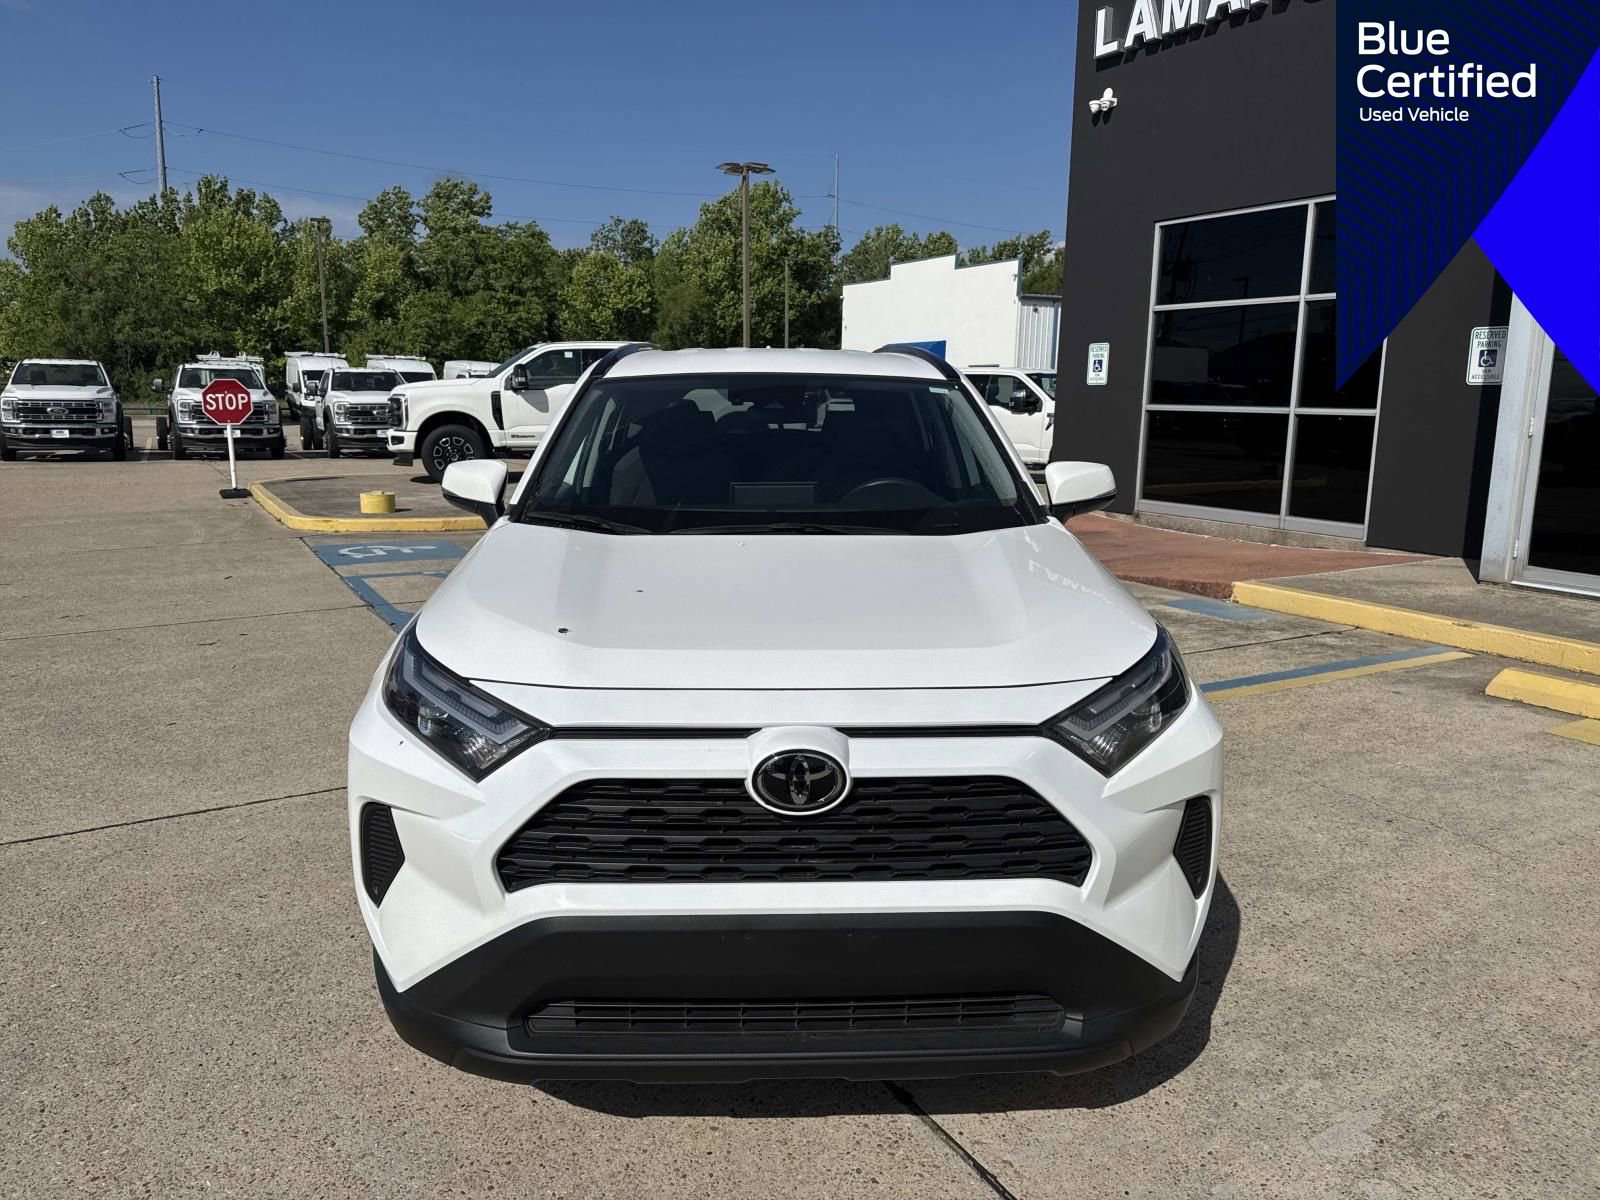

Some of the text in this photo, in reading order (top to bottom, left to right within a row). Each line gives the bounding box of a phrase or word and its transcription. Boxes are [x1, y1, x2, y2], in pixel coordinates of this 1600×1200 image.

[1474, 330, 1507, 340] RESERVED
[1477, 340, 1502, 349] PARKING
[205, 393, 249, 411] STOP
